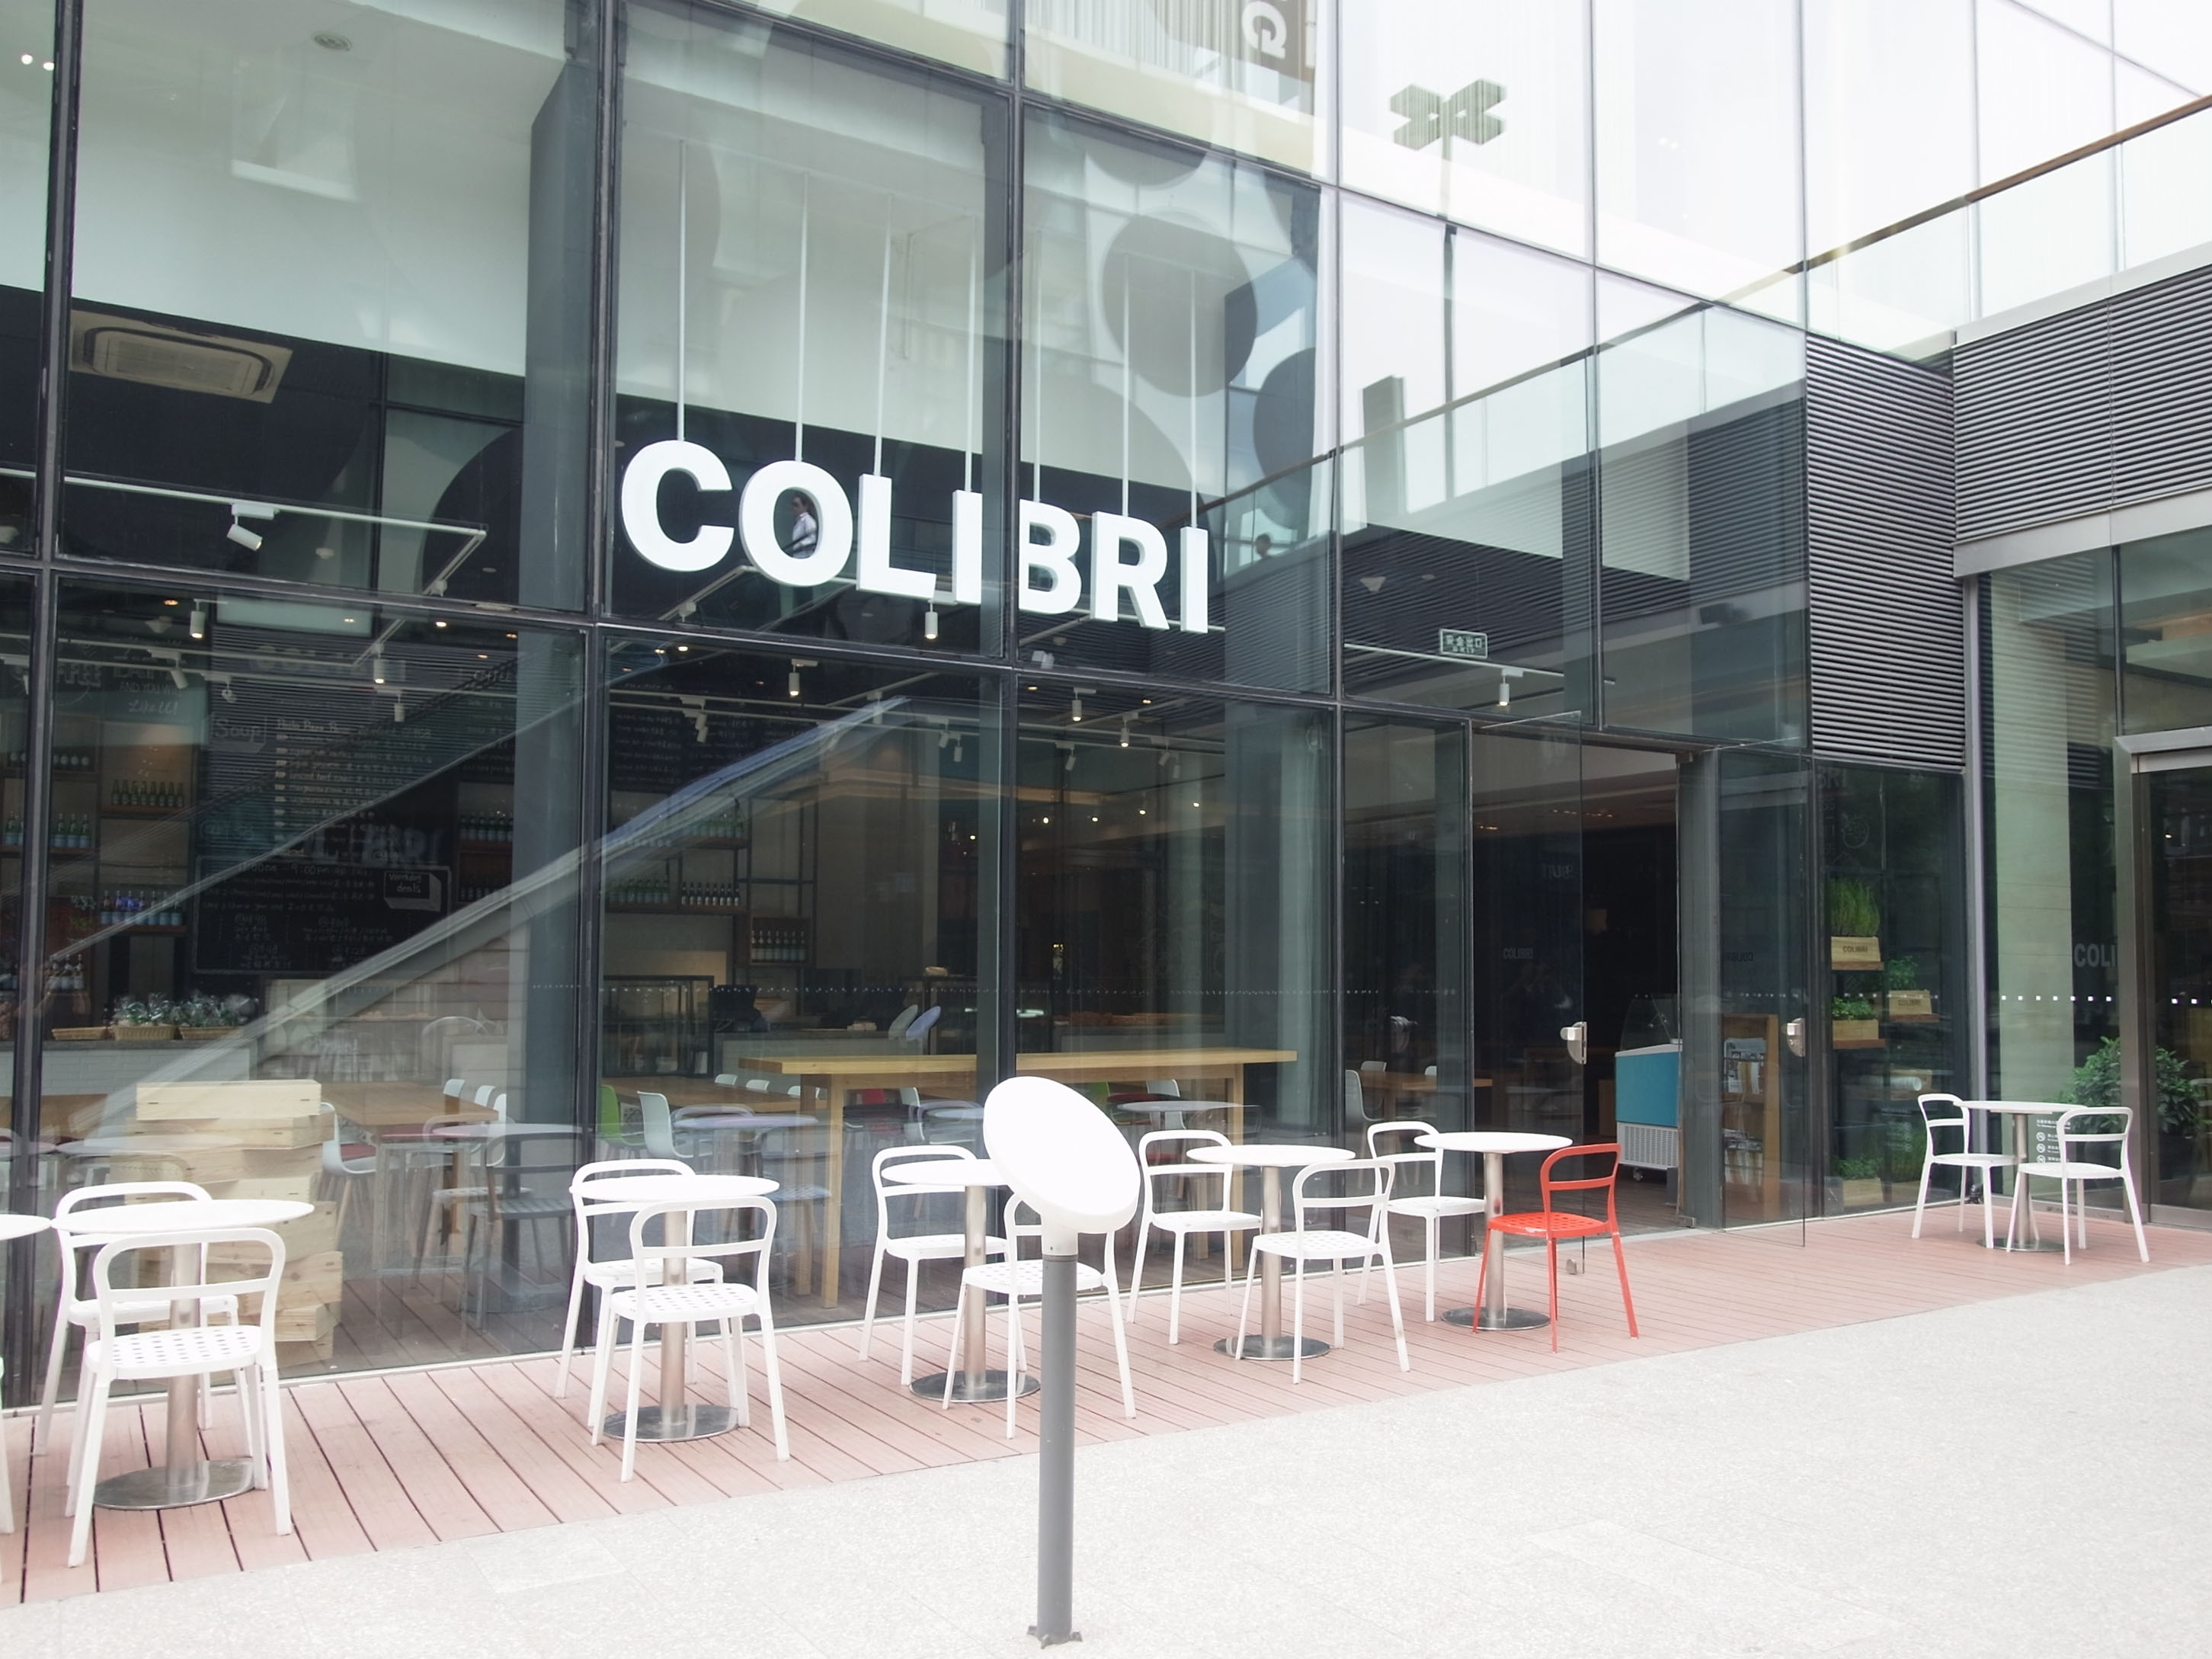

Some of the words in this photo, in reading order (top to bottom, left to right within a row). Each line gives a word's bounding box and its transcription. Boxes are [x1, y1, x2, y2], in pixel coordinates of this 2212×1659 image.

[621, 440, 1208, 633] COLIBRI
[1445, 635, 1482, 648] 安全出口
[1452, 645, 1474, 654] EXIT
[1503, 947, 1534, 959] COLIBRI
